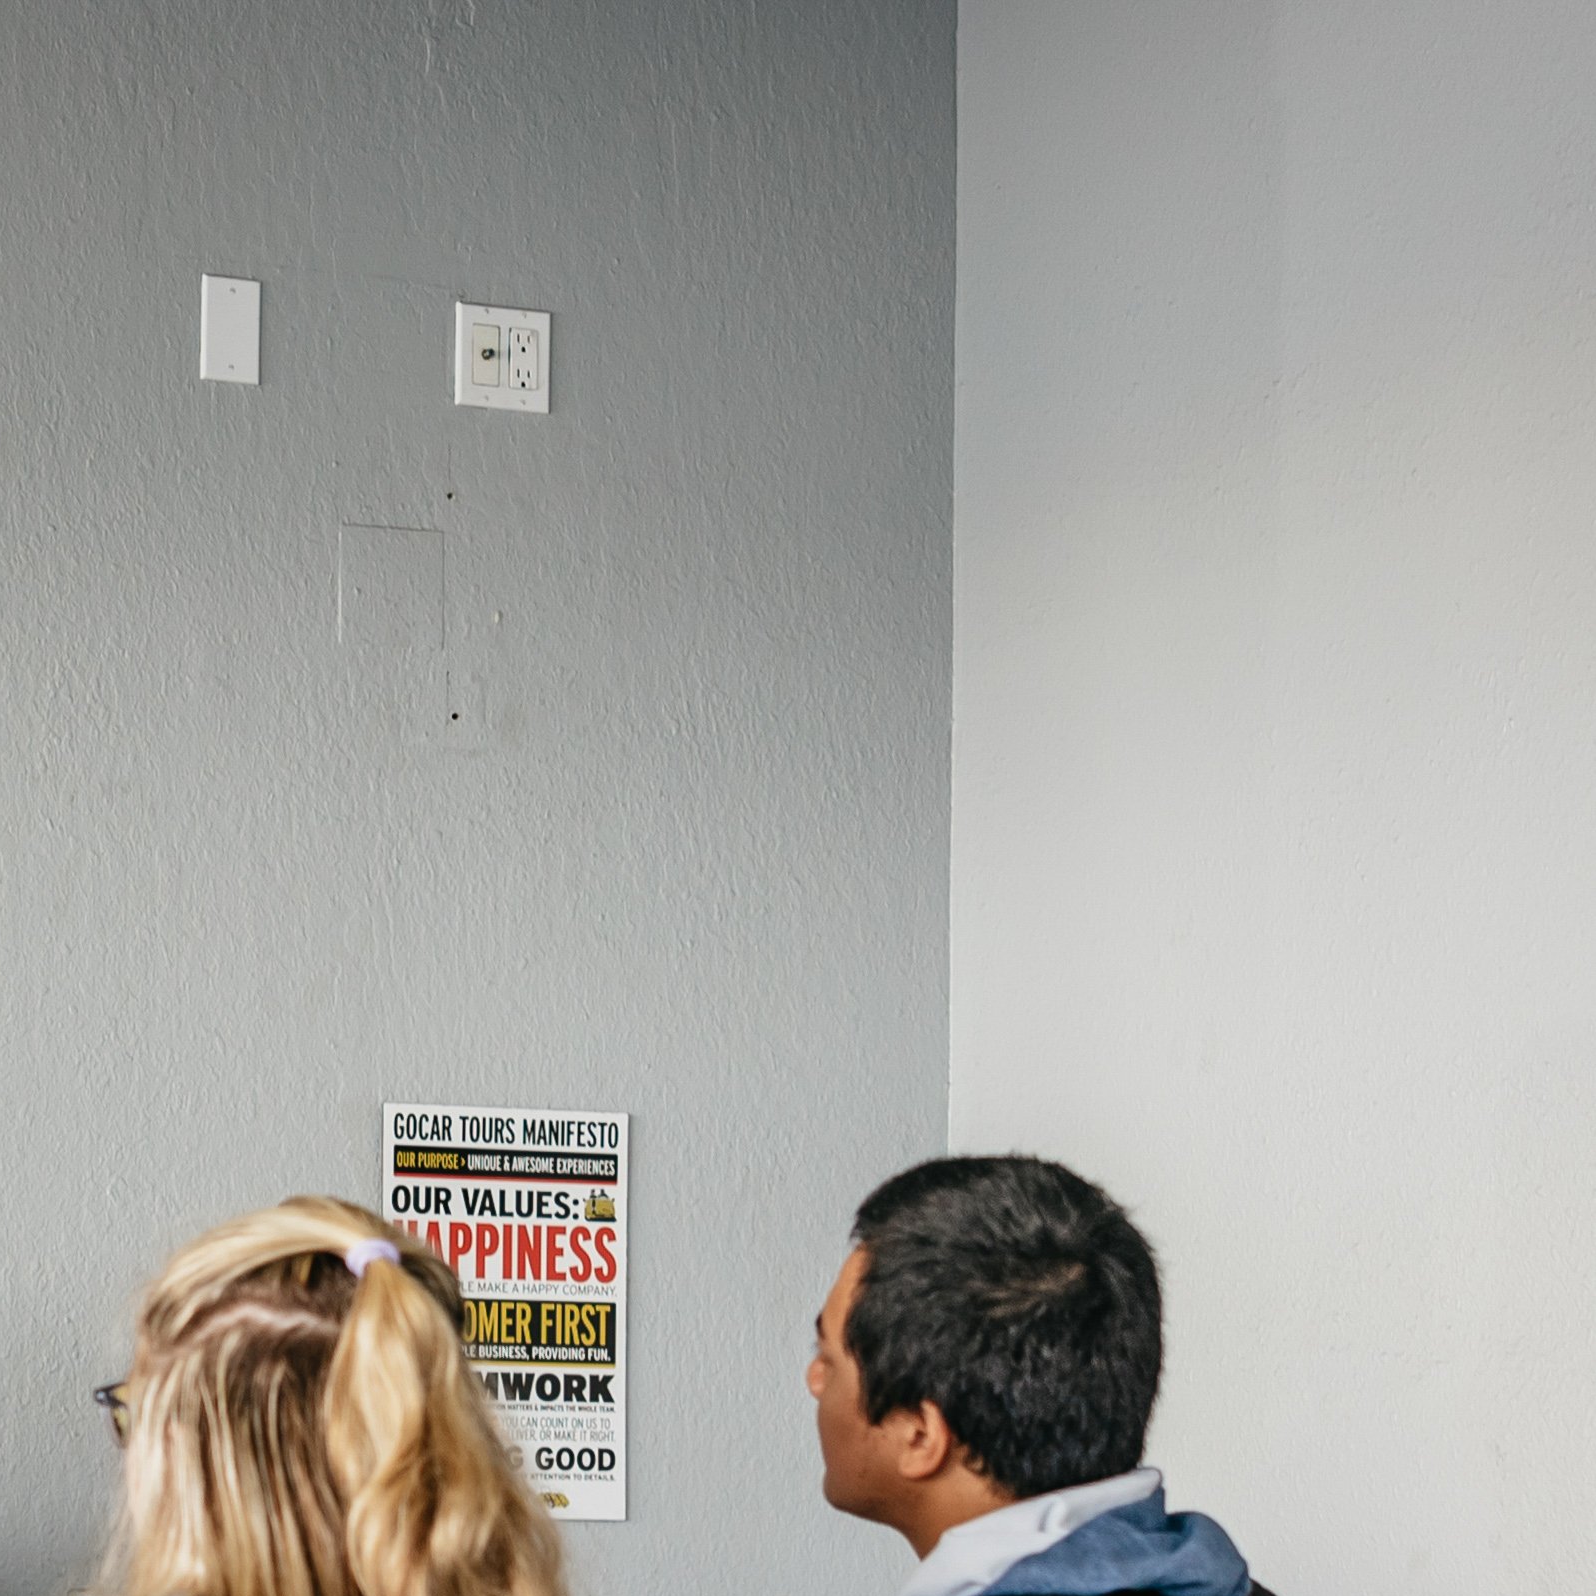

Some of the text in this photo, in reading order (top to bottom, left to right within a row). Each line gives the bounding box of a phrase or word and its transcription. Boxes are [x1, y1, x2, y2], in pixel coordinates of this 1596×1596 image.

[393, 1112, 618, 1148] GOCAR TOURS MANIFESTO
[396, 1150, 615, 1176] OUR PURPOSE UNIQUE & AWESOME EXPERIENCES
[391, 1184, 579, 1220] OUR VALUES:
[393, 1219, 617, 1284] APPINESS
[477, 1281, 616, 1296] MAKE A HAPPY COMPANY.
[464, 1300, 611, 1347] OMER FIRST
[478, 1344, 611, 1361] BUSINESS, PROVIDING FUN.
[535, 1446, 615, 1471] GOOD
